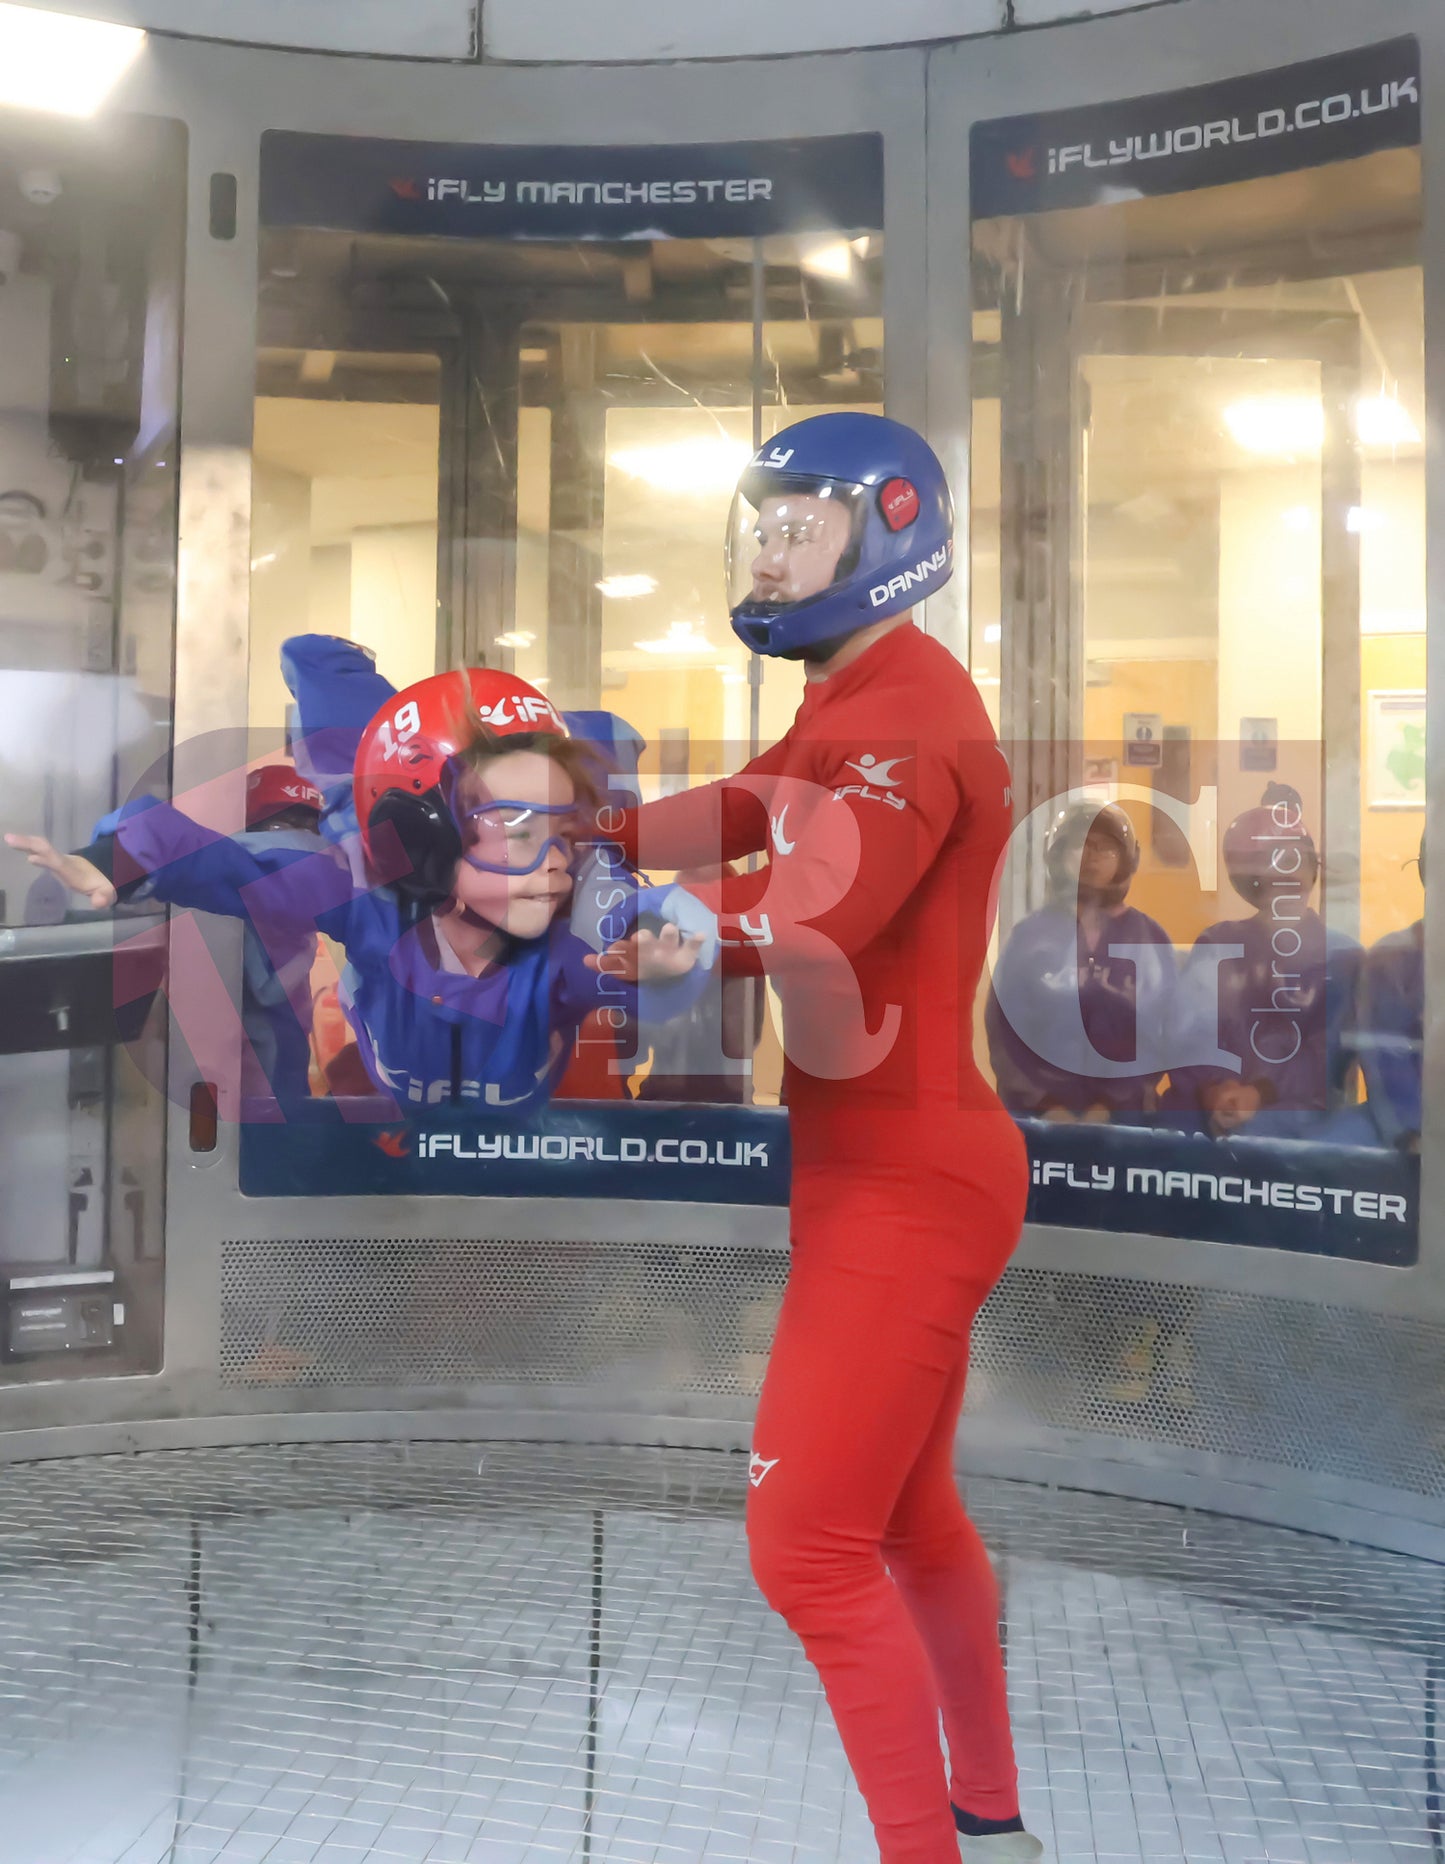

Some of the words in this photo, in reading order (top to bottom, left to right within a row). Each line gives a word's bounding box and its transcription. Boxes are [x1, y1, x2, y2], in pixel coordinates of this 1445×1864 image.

[1047, 76, 1419, 175] iFLYWORLD.CO.UK
[427, 178, 506, 202] iFLY
[516, 178, 773, 205] MANCHESTER
[869, 545, 947, 608] DANNY
[383, 701, 422, 762] 19
[832, 784, 907, 811] iFLY
[418, 1133, 770, 1168] iFLYWORLD.CO.UK
[1033, 1160, 1115, 1191] iFLY
[1126, 1167, 1408, 1223] MANCHESTER
